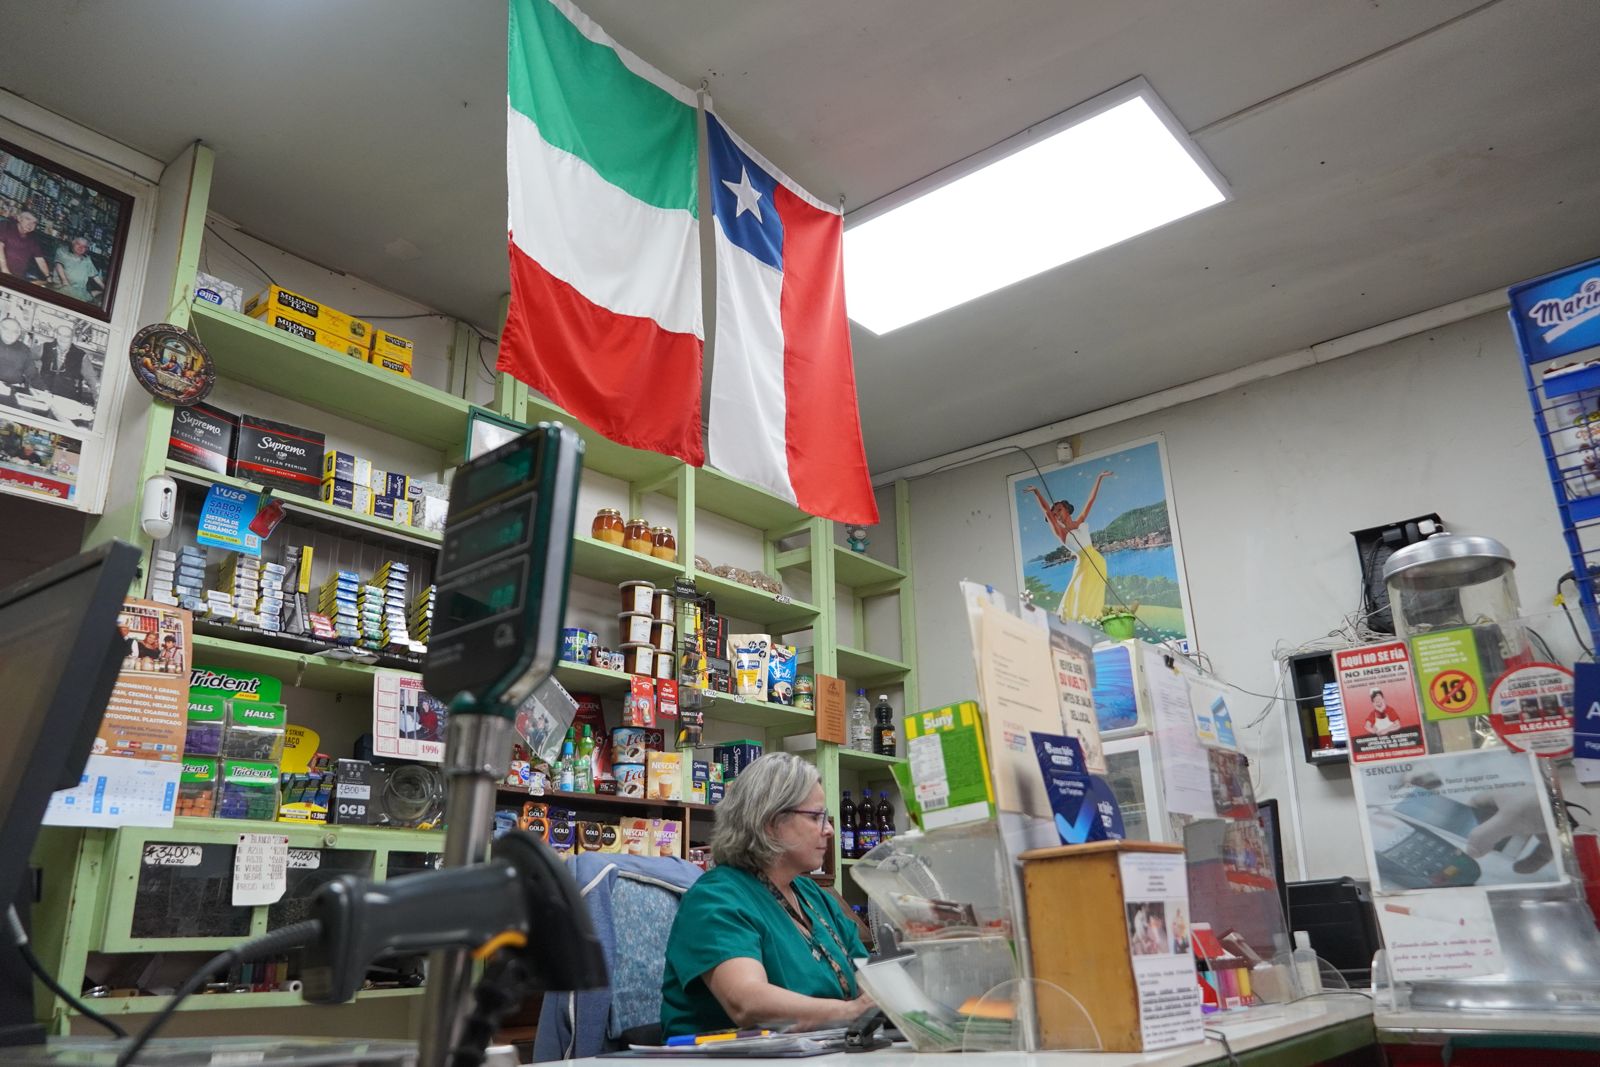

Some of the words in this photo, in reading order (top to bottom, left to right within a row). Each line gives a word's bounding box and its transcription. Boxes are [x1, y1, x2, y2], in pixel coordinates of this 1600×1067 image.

[280, 291, 317, 311] MILDRED
[290, 301, 308, 313] TEA
[277, 317, 315, 336] MILDRED
[288, 326, 304, 338] TEA
[177, 410, 221, 434] Supremo
[257, 436, 305, 456] Supremo
[284, 462, 307, 471] PREMIUM
[207, 507, 240, 519] INTENSO
[209, 500, 242, 514] SABOR
[203, 523, 238, 536] CERÁMICO
[1341, 653, 1363, 668] AQUÍ
[1363, 652, 1377, 663] NO
[1378, 650, 1390, 661] SE
[1390, 647, 1405, 660] FÍA
[1345, 671, 1360, 679] NO
[1363, 664, 1405, 677] INSISTA
[189, 668, 260, 694] Trident
[1440, 677, 1467, 705] 18
[187, 702, 214, 713] ALLS
[105, 713, 141, 723] OTOCOPIAS,
[244, 709, 276, 720] HALLS
[1519, 719, 1570, 731] ILEGALES
[421, 743, 440, 755] 1996
[181, 764, 209, 774] dent
[231, 765, 273, 777] Trident
[651, 760, 680, 770] NESCAFÉ
[1365, 763, 1413, 777] SENCILLO
[1445, 775, 1464, 784] favor
[1464, 774, 1485, 785] pagar
[1447, 784, 1494, 794] transferencia
[338, 803, 366, 816] OCB
[528, 824, 545, 832] GOLD
[554, 826, 570, 835] GOLD
[585, 828, 600, 837] GOLD
